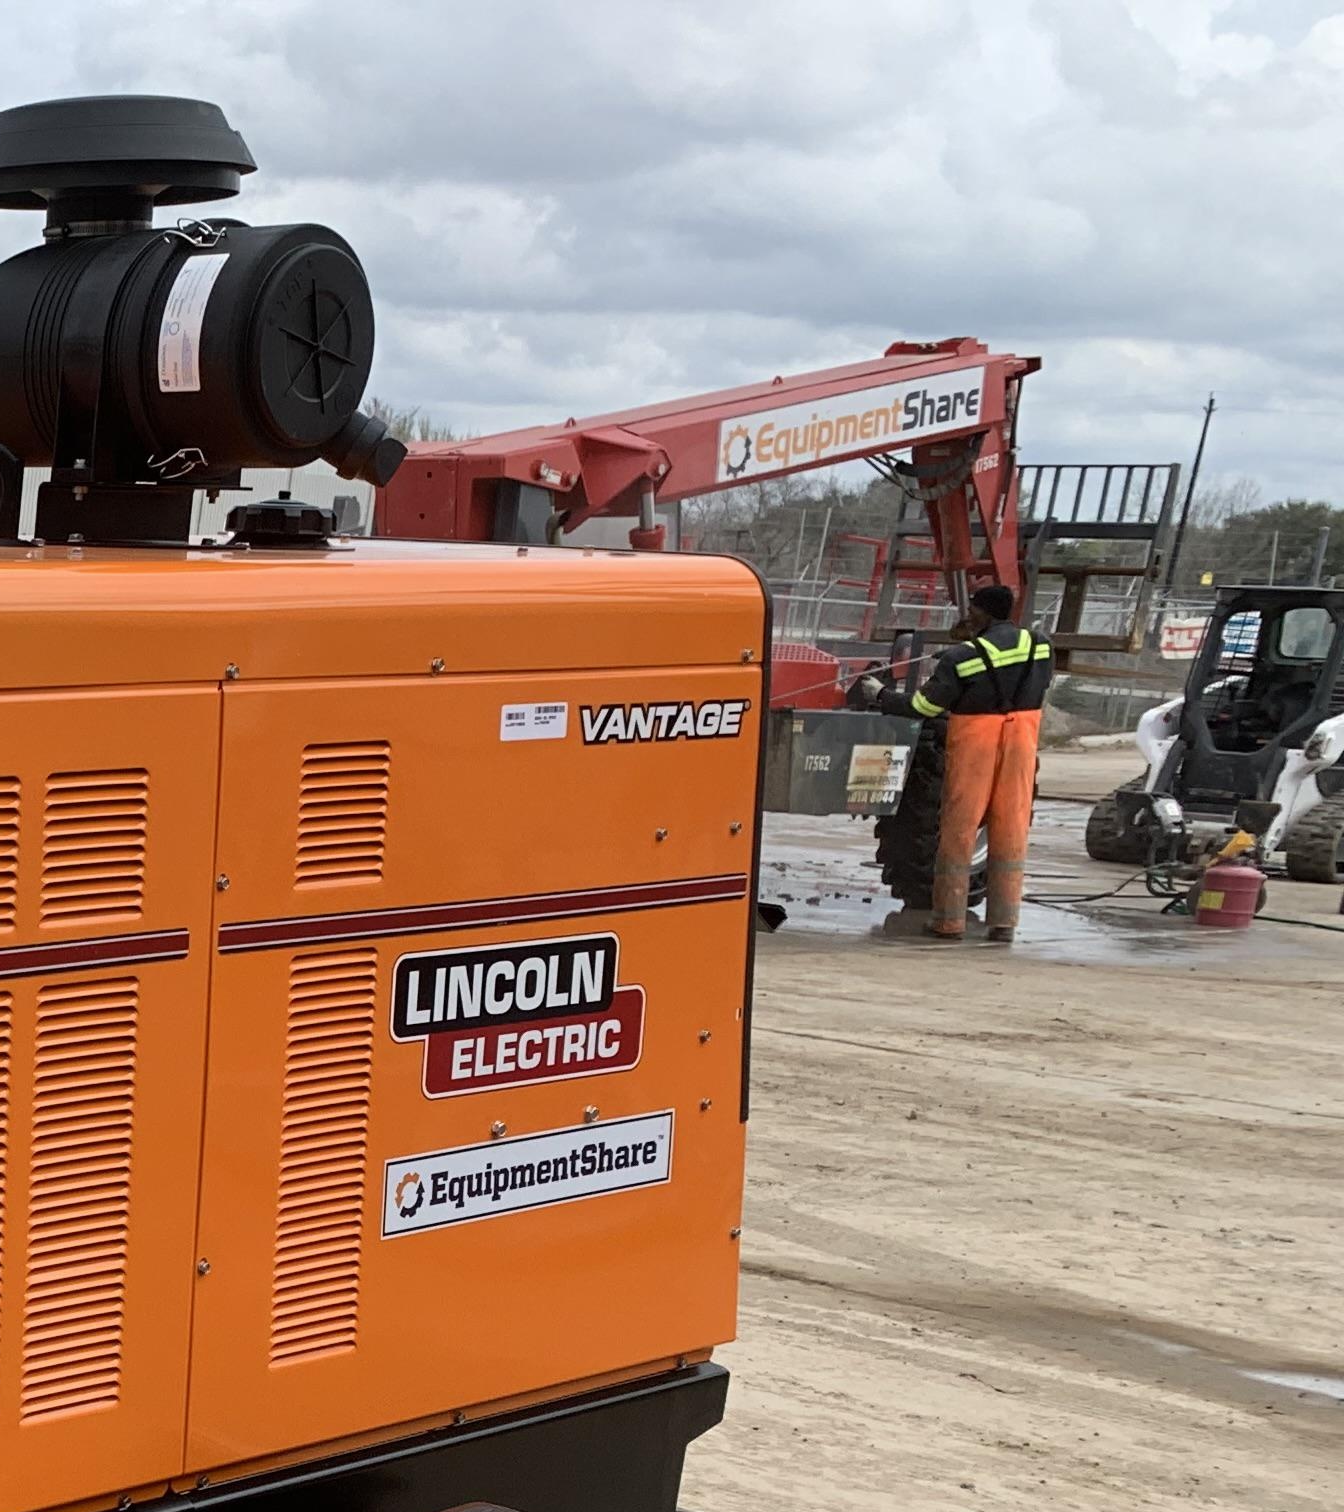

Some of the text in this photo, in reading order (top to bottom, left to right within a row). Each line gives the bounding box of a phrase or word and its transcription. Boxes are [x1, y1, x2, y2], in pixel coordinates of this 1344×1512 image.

[755, 387, 980, 467] EquipmentShare
[580, 702, 746, 743] VANTAGE
[804, 755, 831, 772] 17562
[405, 949, 606, 1026] LINCOLN
[450, 1018, 622, 1081] ELECTRIC
[429, 1138, 658, 1210] EquipmentShare
